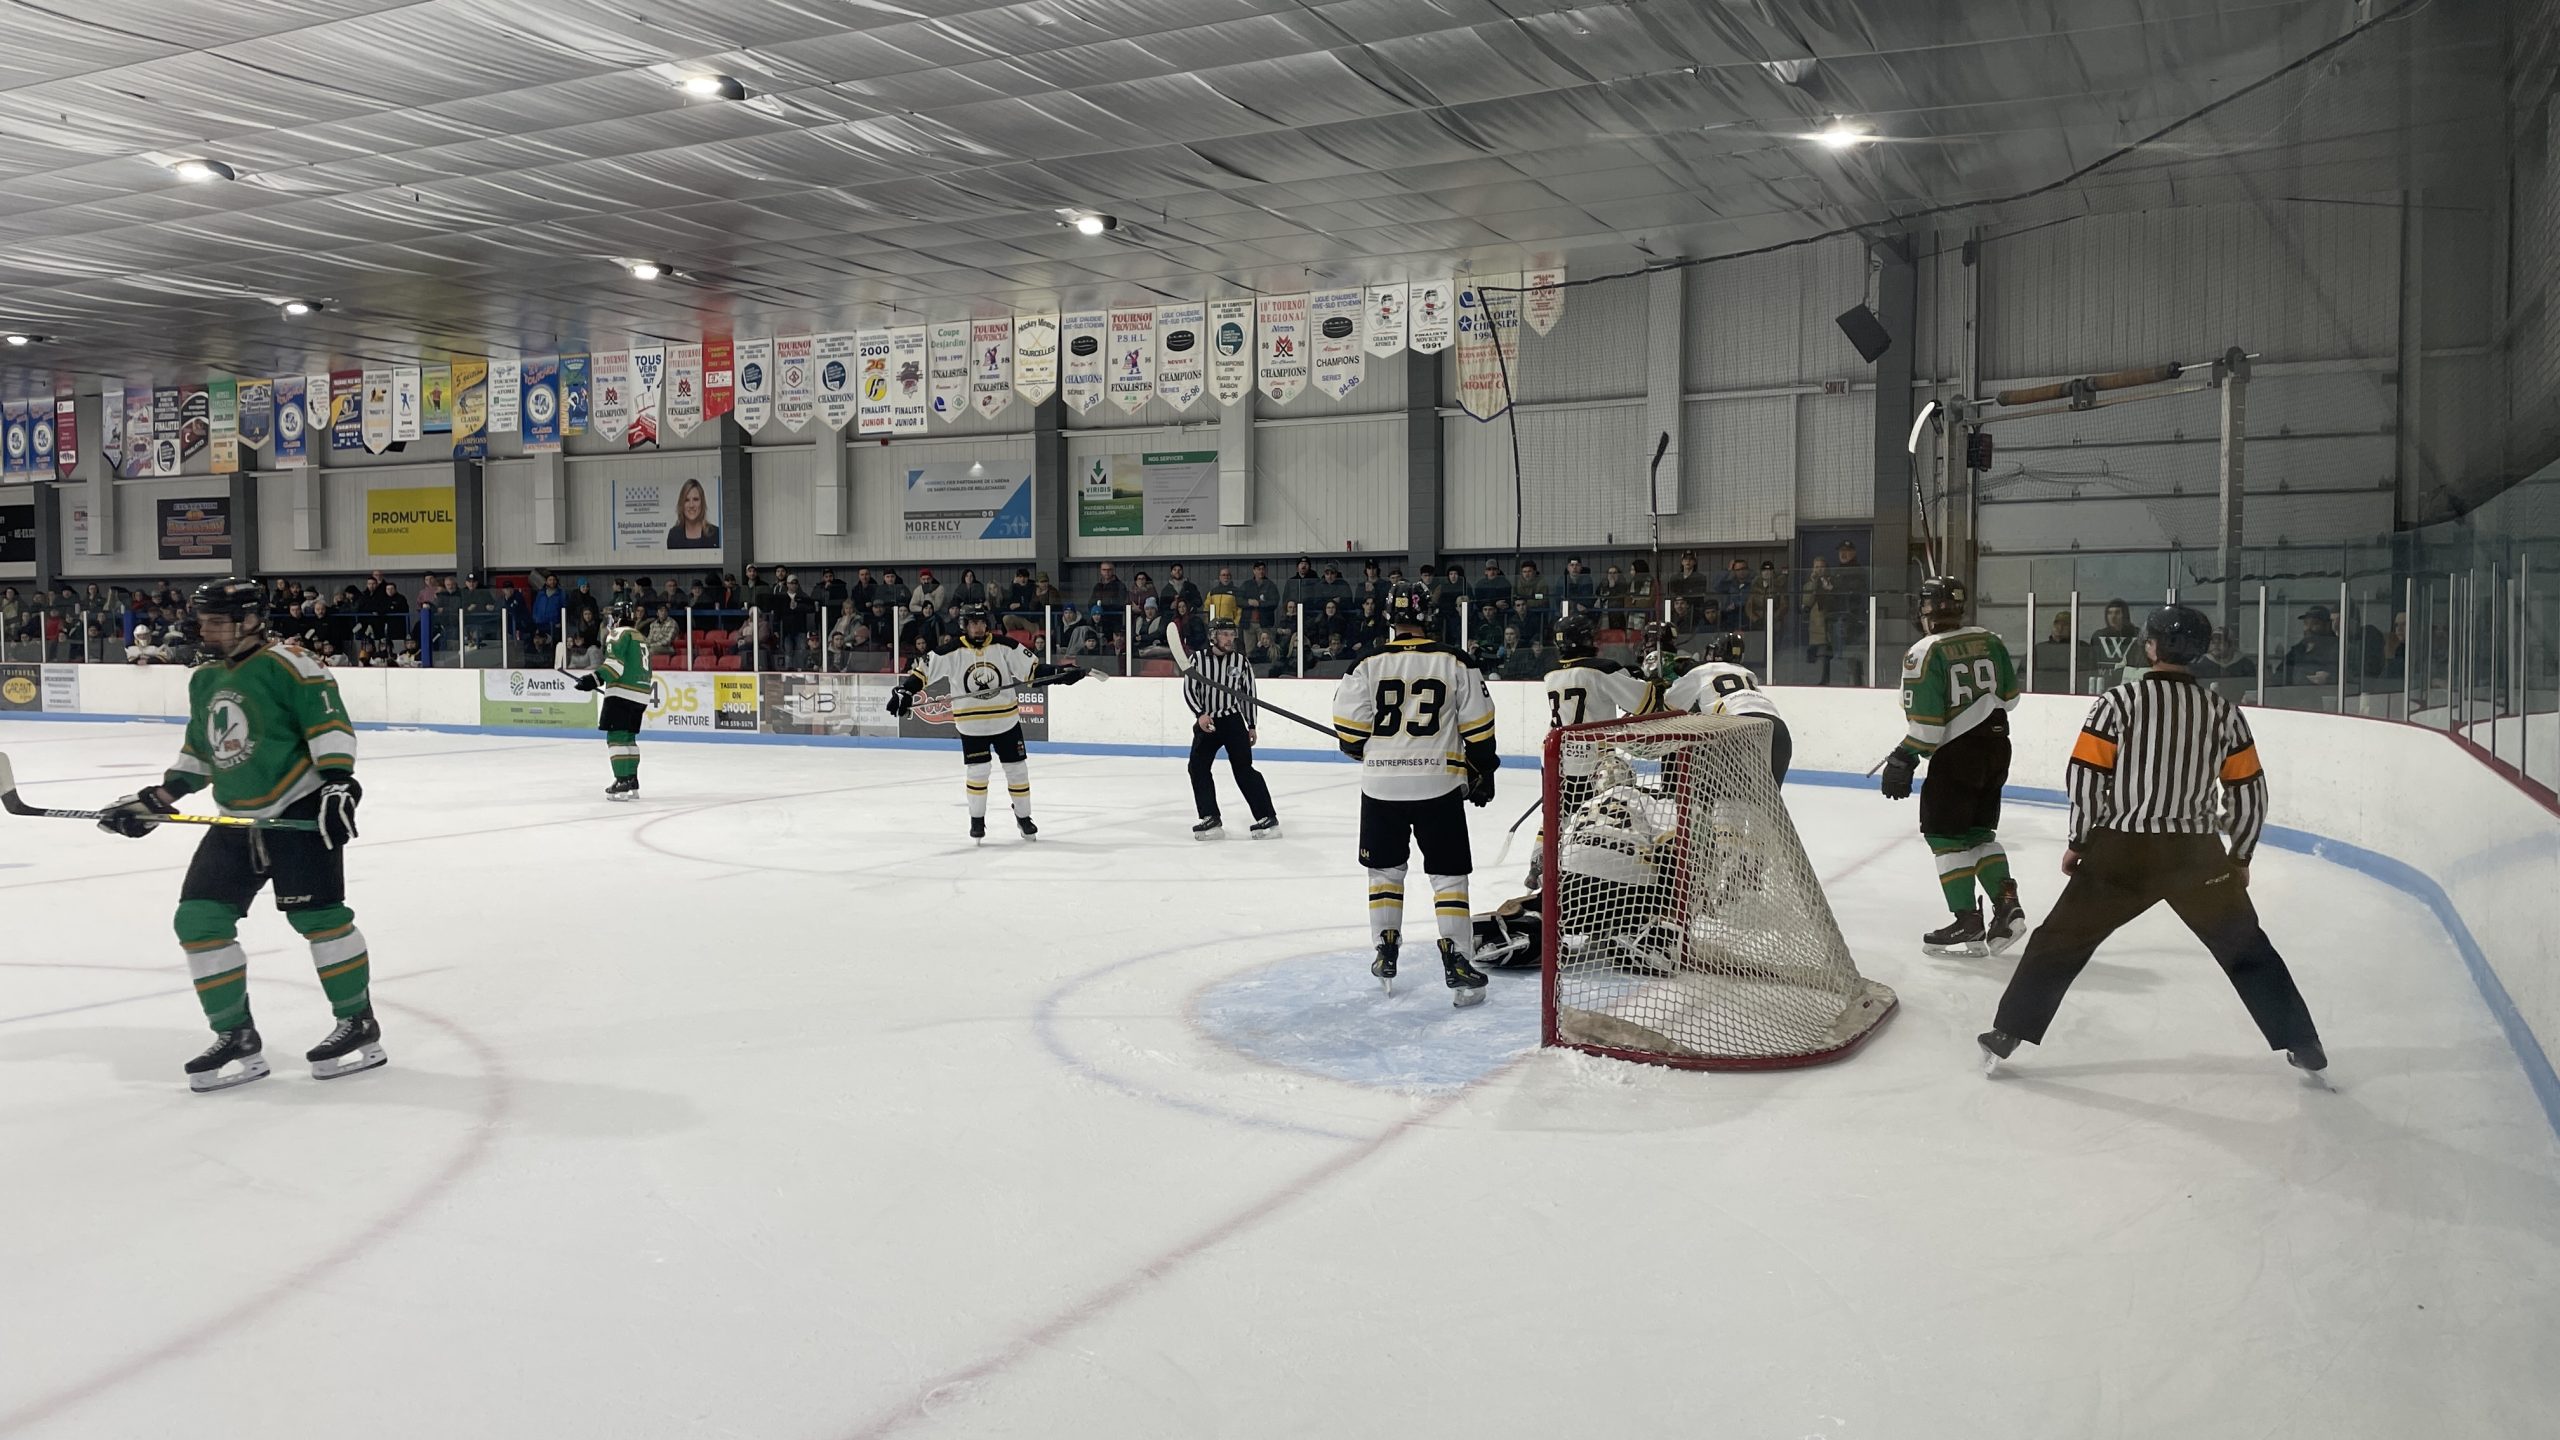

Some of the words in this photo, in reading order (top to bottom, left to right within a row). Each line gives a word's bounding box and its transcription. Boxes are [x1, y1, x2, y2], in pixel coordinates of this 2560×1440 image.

[1273, 299, 1306, 310] TOURNOI
[1112, 312, 1153, 323] TOURNOI
[1261, 312, 1305, 323] REGIONAL
[973, 323, 1009, 334] TOURNOI
[1112, 322, 1152, 332] PROVINCIAL
[938, 329, 960, 338] Coupe
[777, 340, 811, 350] TOURNOI
[861, 345, 890, 357] 2000
[635, 354, 661, 366] TOUS
[1316, 356, 1360, 368] CHAMPIONS
[639, 365, 658, 374] VERS
[1261, 367, 1307, 379] CHAMPIONS
[1159, 370, 1202, 384] CHAMPIONS
[1111, 382, 1153, 393] FINALISTES
[1338, 375, 1360, 396] 94-95
[861, 405, 891, 415] FINALISTE
[895, 406, 924, 415] FINALISTE
[862, 418, 885, 427] JUNIOR
[895, 418, 917, 427] JUNIOR
[372, 510, 453, 524] PROMUTUEL
[617, 521, 642, 529] Stéphanie
[905, 520, 961, 532] MORENCY
[372, 527, 409, 535] ASSURANCE
[527, 678, 565, 690] Avantis
[1950, 658, 1998, 708] 69
[732, 691, 741, 699] ON
[722, 702, 751, 714] SHOOT
[799, 692, 837, 713] MB
[1372, 678, 1447, 737] 83
[668, 715, 710, 726] PEINTURE
[1376, 758, 1424, 768] ENTREPRISES
[276, 894, 312, 904] CCM
